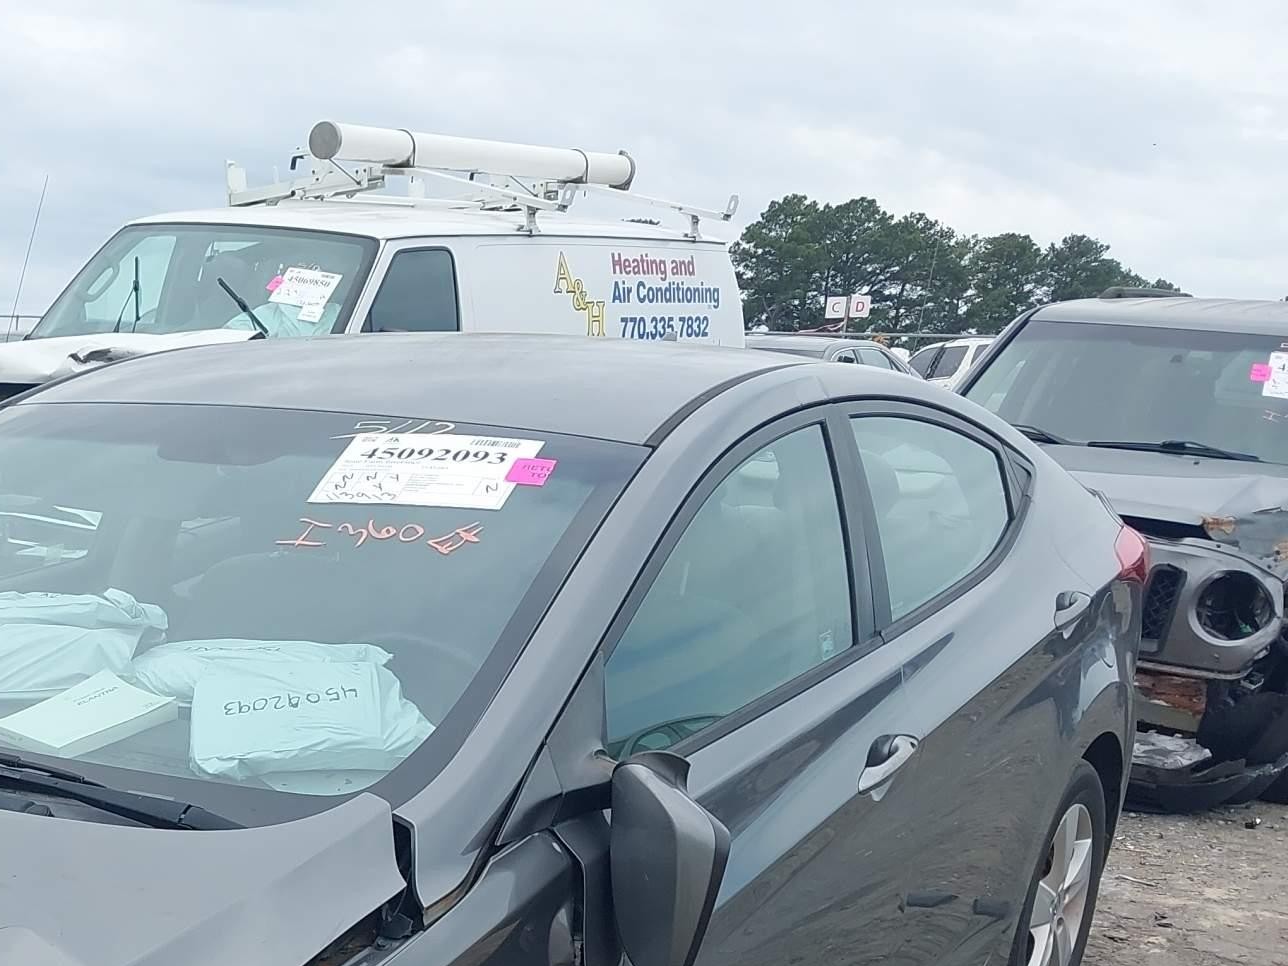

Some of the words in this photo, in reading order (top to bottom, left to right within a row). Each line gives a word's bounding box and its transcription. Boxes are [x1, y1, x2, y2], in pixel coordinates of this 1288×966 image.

[611, 252, 668, 281] Heating
[671, 255, 696, 277] and
[612, 280, 633, 304] Air
[636, 280, 720, 309] Conditioning
[831, 301, 841, 313] C
[855, 301, 865, 313] D
[620, 316, 709, 341] 770.335.7832
[360, 446, 509, 465] 45092093
[223, 684, 359, 717] 45092093
